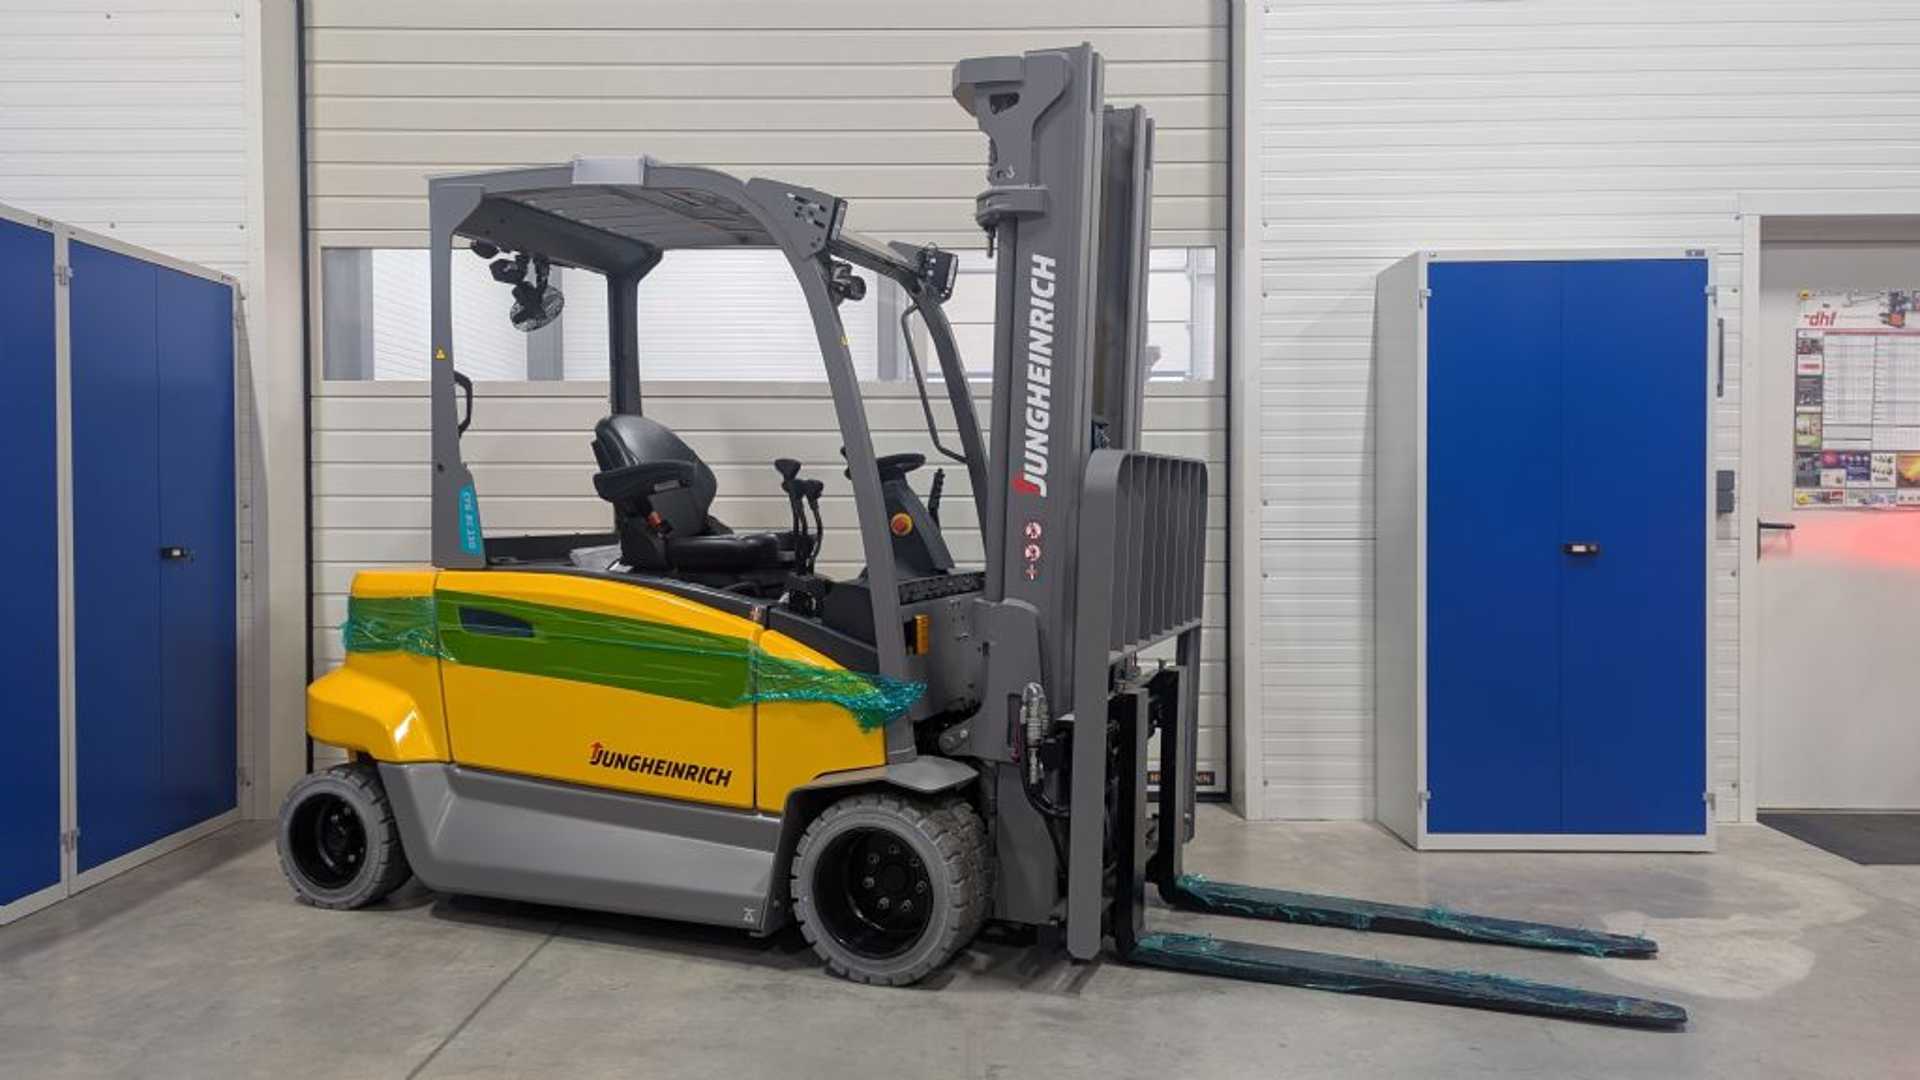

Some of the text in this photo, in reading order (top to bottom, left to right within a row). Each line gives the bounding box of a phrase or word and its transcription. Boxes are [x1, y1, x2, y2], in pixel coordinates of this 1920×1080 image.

[1807, 311, 1837, 327] dhf
[1019, 254, 1056, 498] JUNGHEINRICH
[589, 745, 733, 788] JUNGHEINRICH
